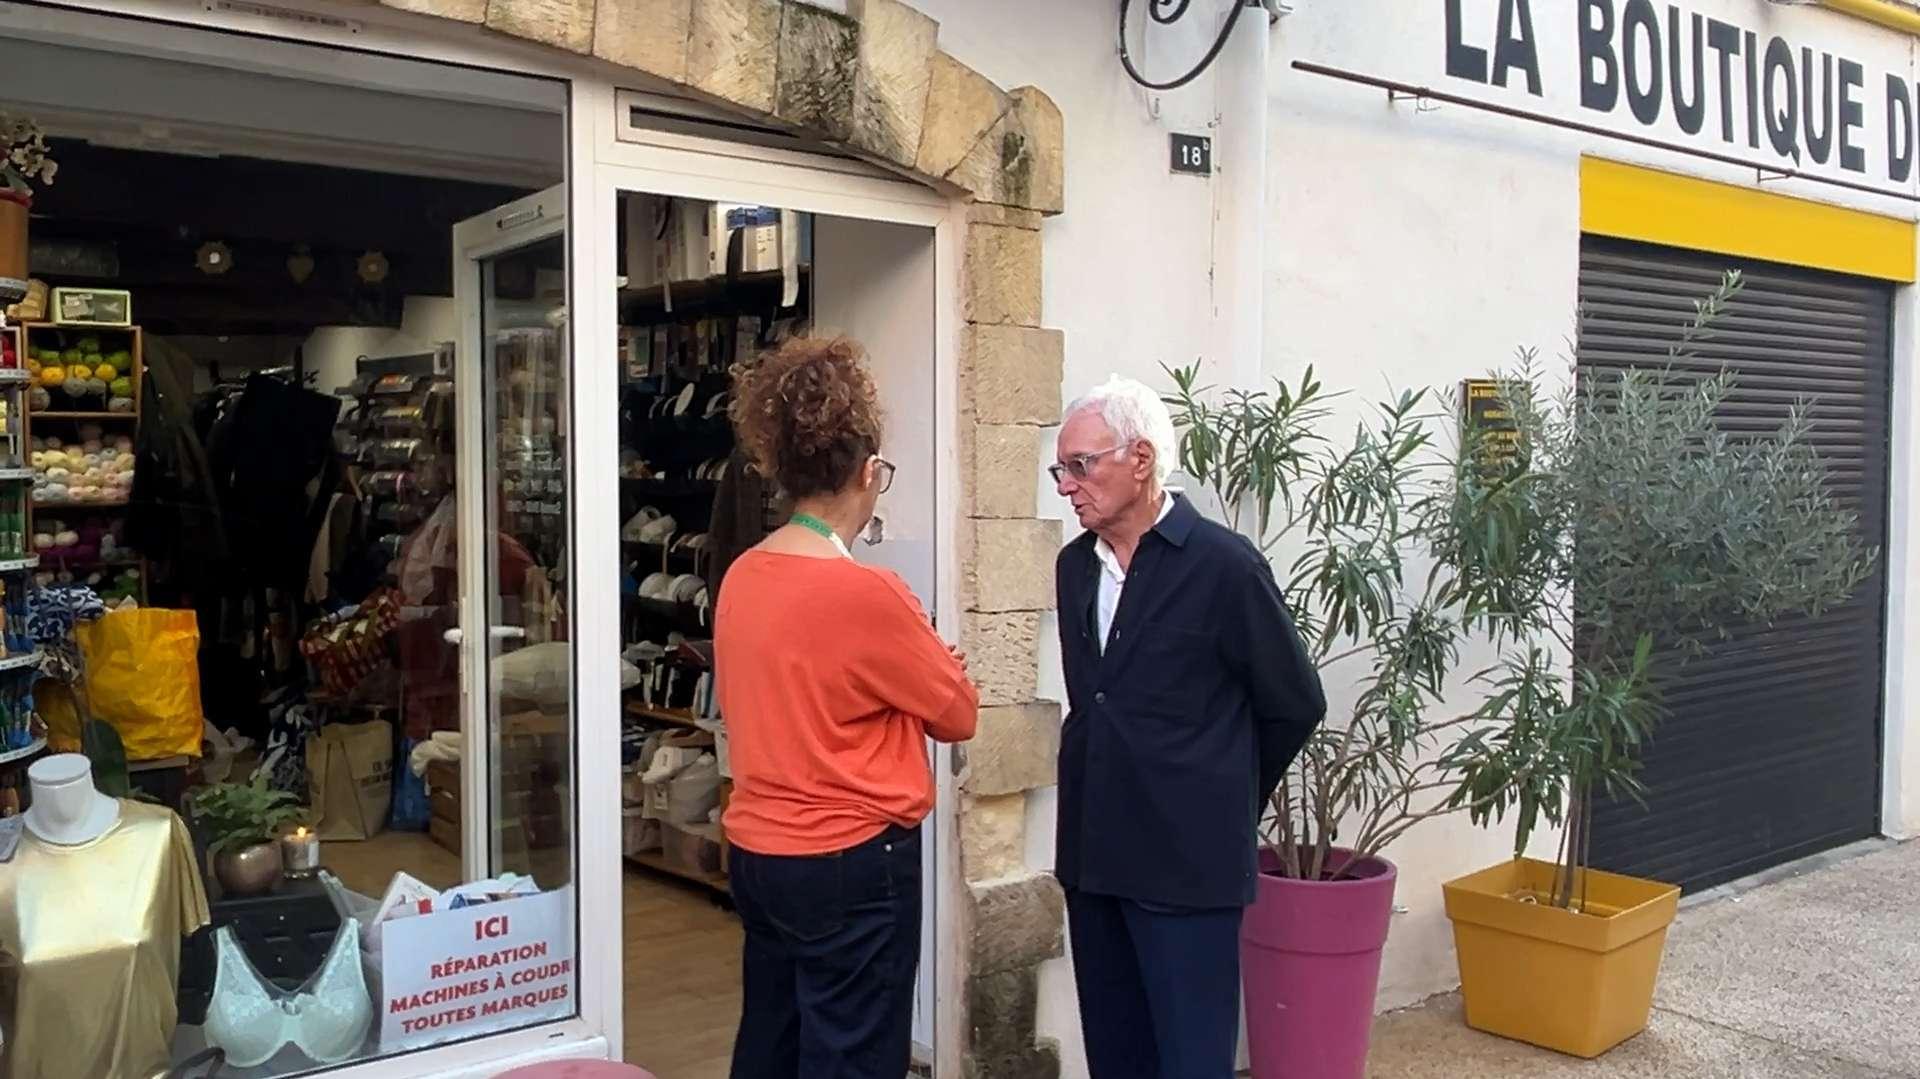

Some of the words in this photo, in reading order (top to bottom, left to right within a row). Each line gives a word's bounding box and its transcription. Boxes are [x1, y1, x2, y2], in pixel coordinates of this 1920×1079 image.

[1446, 0, 1542, 96] LA
[1579, 0, 1865, 172] BOUTIQUE
[1887, 73, 1920, 184] D
[475, 916, 509, 940] ICI
[431, 942, 547, 979] RÉPARATION
[390, 979, 489, 1013] MACHINES
[494, 972, 506, 990] À
[402, 1006, 476, 1033] TOUTES
[481, 984, 568, 1014] MARQUES
